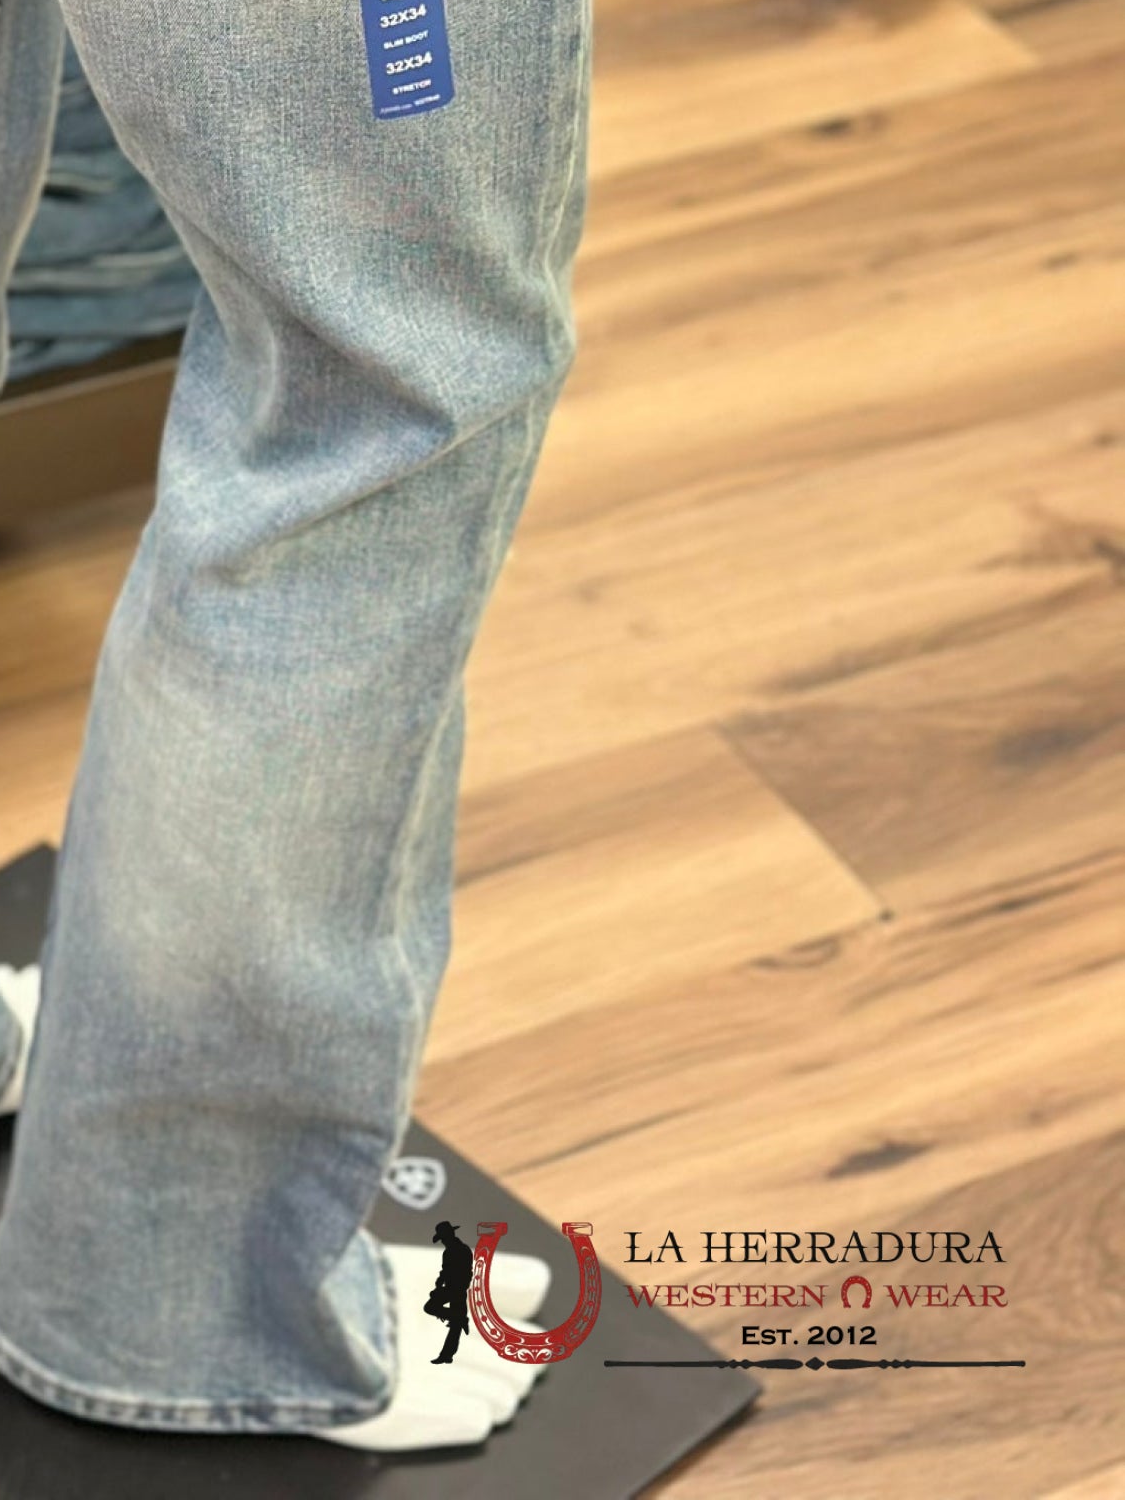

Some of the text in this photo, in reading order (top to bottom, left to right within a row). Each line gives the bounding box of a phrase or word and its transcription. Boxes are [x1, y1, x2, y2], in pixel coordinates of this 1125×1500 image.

[380, 3, 427, 28] 32X34
[405, 29, 429, 44] BOOT
[386, 51, 433, 75] 32X34
